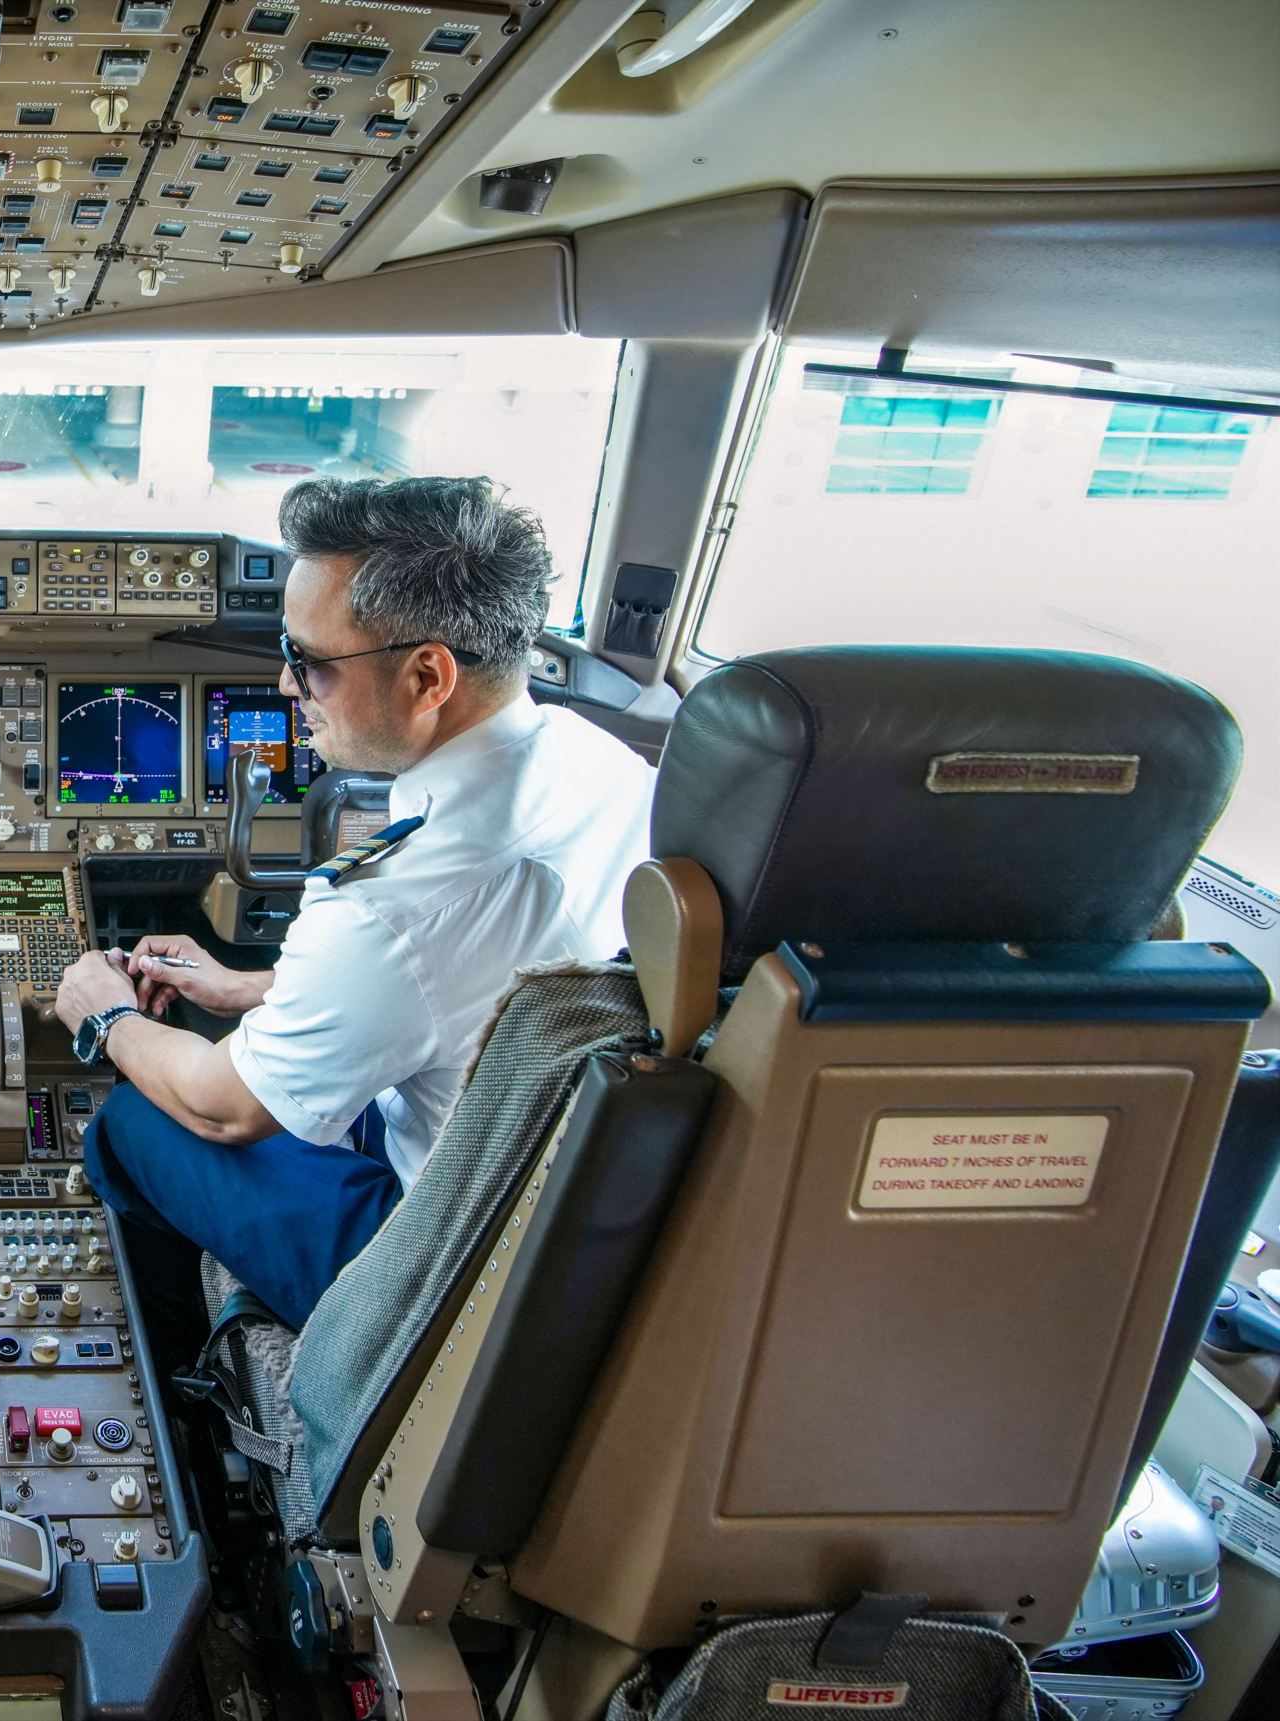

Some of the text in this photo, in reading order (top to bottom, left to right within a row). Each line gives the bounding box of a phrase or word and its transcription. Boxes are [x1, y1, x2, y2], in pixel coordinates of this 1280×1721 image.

[256, 1, 301, 11] COOLING
[345, 0, 432, 15] CONDITIONING
[443, 22, 480, 31] GASPER
[322, 36, 348, 44] UPPER
[328, 31, 386, 43] RECIRC FANS
[262, 42, 287, 51] DECK
[357, 40, 390, 48] LOWER
[327, 75, 354, 83] COND
[261, 146, 288, 154] BLEED
[207, 213, 276, 223] PRESSURIZATION
[932, 1134, 1049, 1146] SEAT MUST BE IN
[878, 1155, 1089, 1169] FORWARD 7 INCHES OF TRAVEL
[872, 1177, 1085, 1191] DURING TAKEOFF AND LANDING
[43, 1410, 74, 1419] EVAC
[355, 1691, 363, 1708] OFF
[784, 1686, 895, 1704] LIFEVESTS
